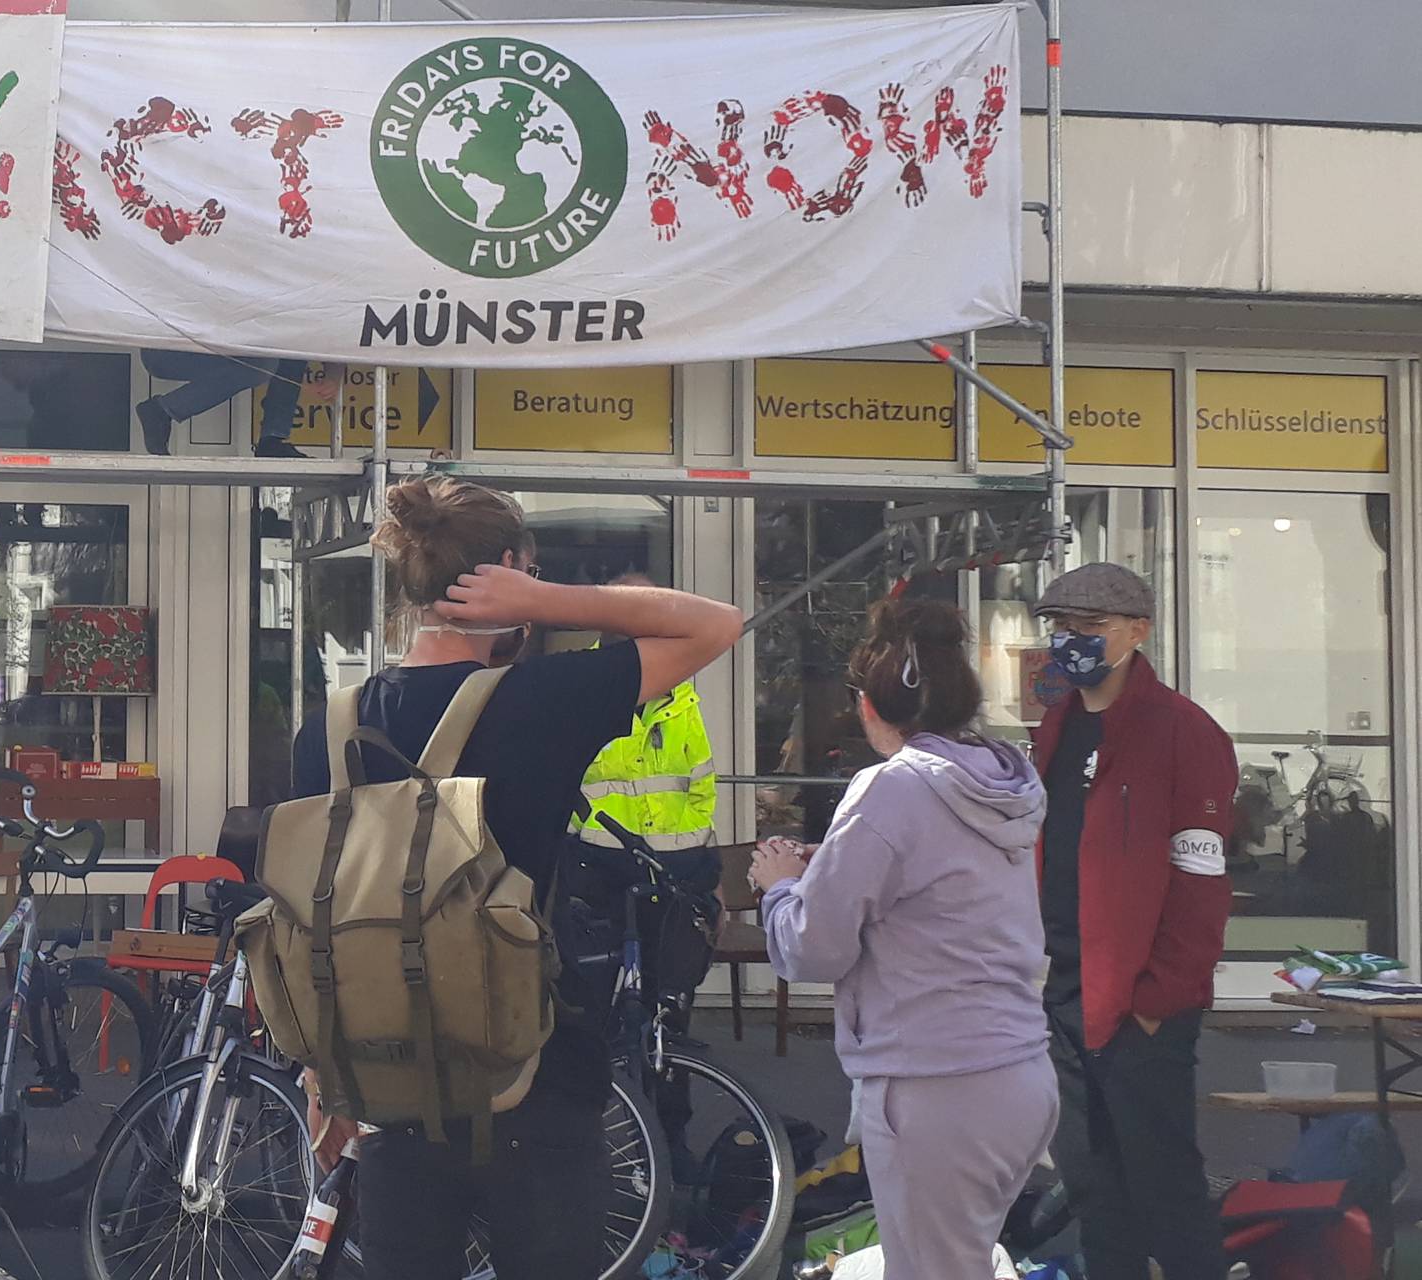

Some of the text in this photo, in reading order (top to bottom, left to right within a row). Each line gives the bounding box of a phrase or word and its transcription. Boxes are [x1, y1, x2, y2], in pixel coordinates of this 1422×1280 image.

[378, 43, 572, 158] FRIDAYS FOR
[642, 64, 1008, 242] NOW
[468, 186, 612, 270] FUTURE
[358, 287, 646, 348] MÜNSTER
[291, 395, 402, 431] ervice
[513, 390, 635, 422] Beratung
[755, 395, 955, 429] Wertschätzung
[1014, 401, 1143, 428] Anebote
[1195, 407, 1389, 436] Schlüsseldienst
[1178, 839, 1219, 855] DNER
